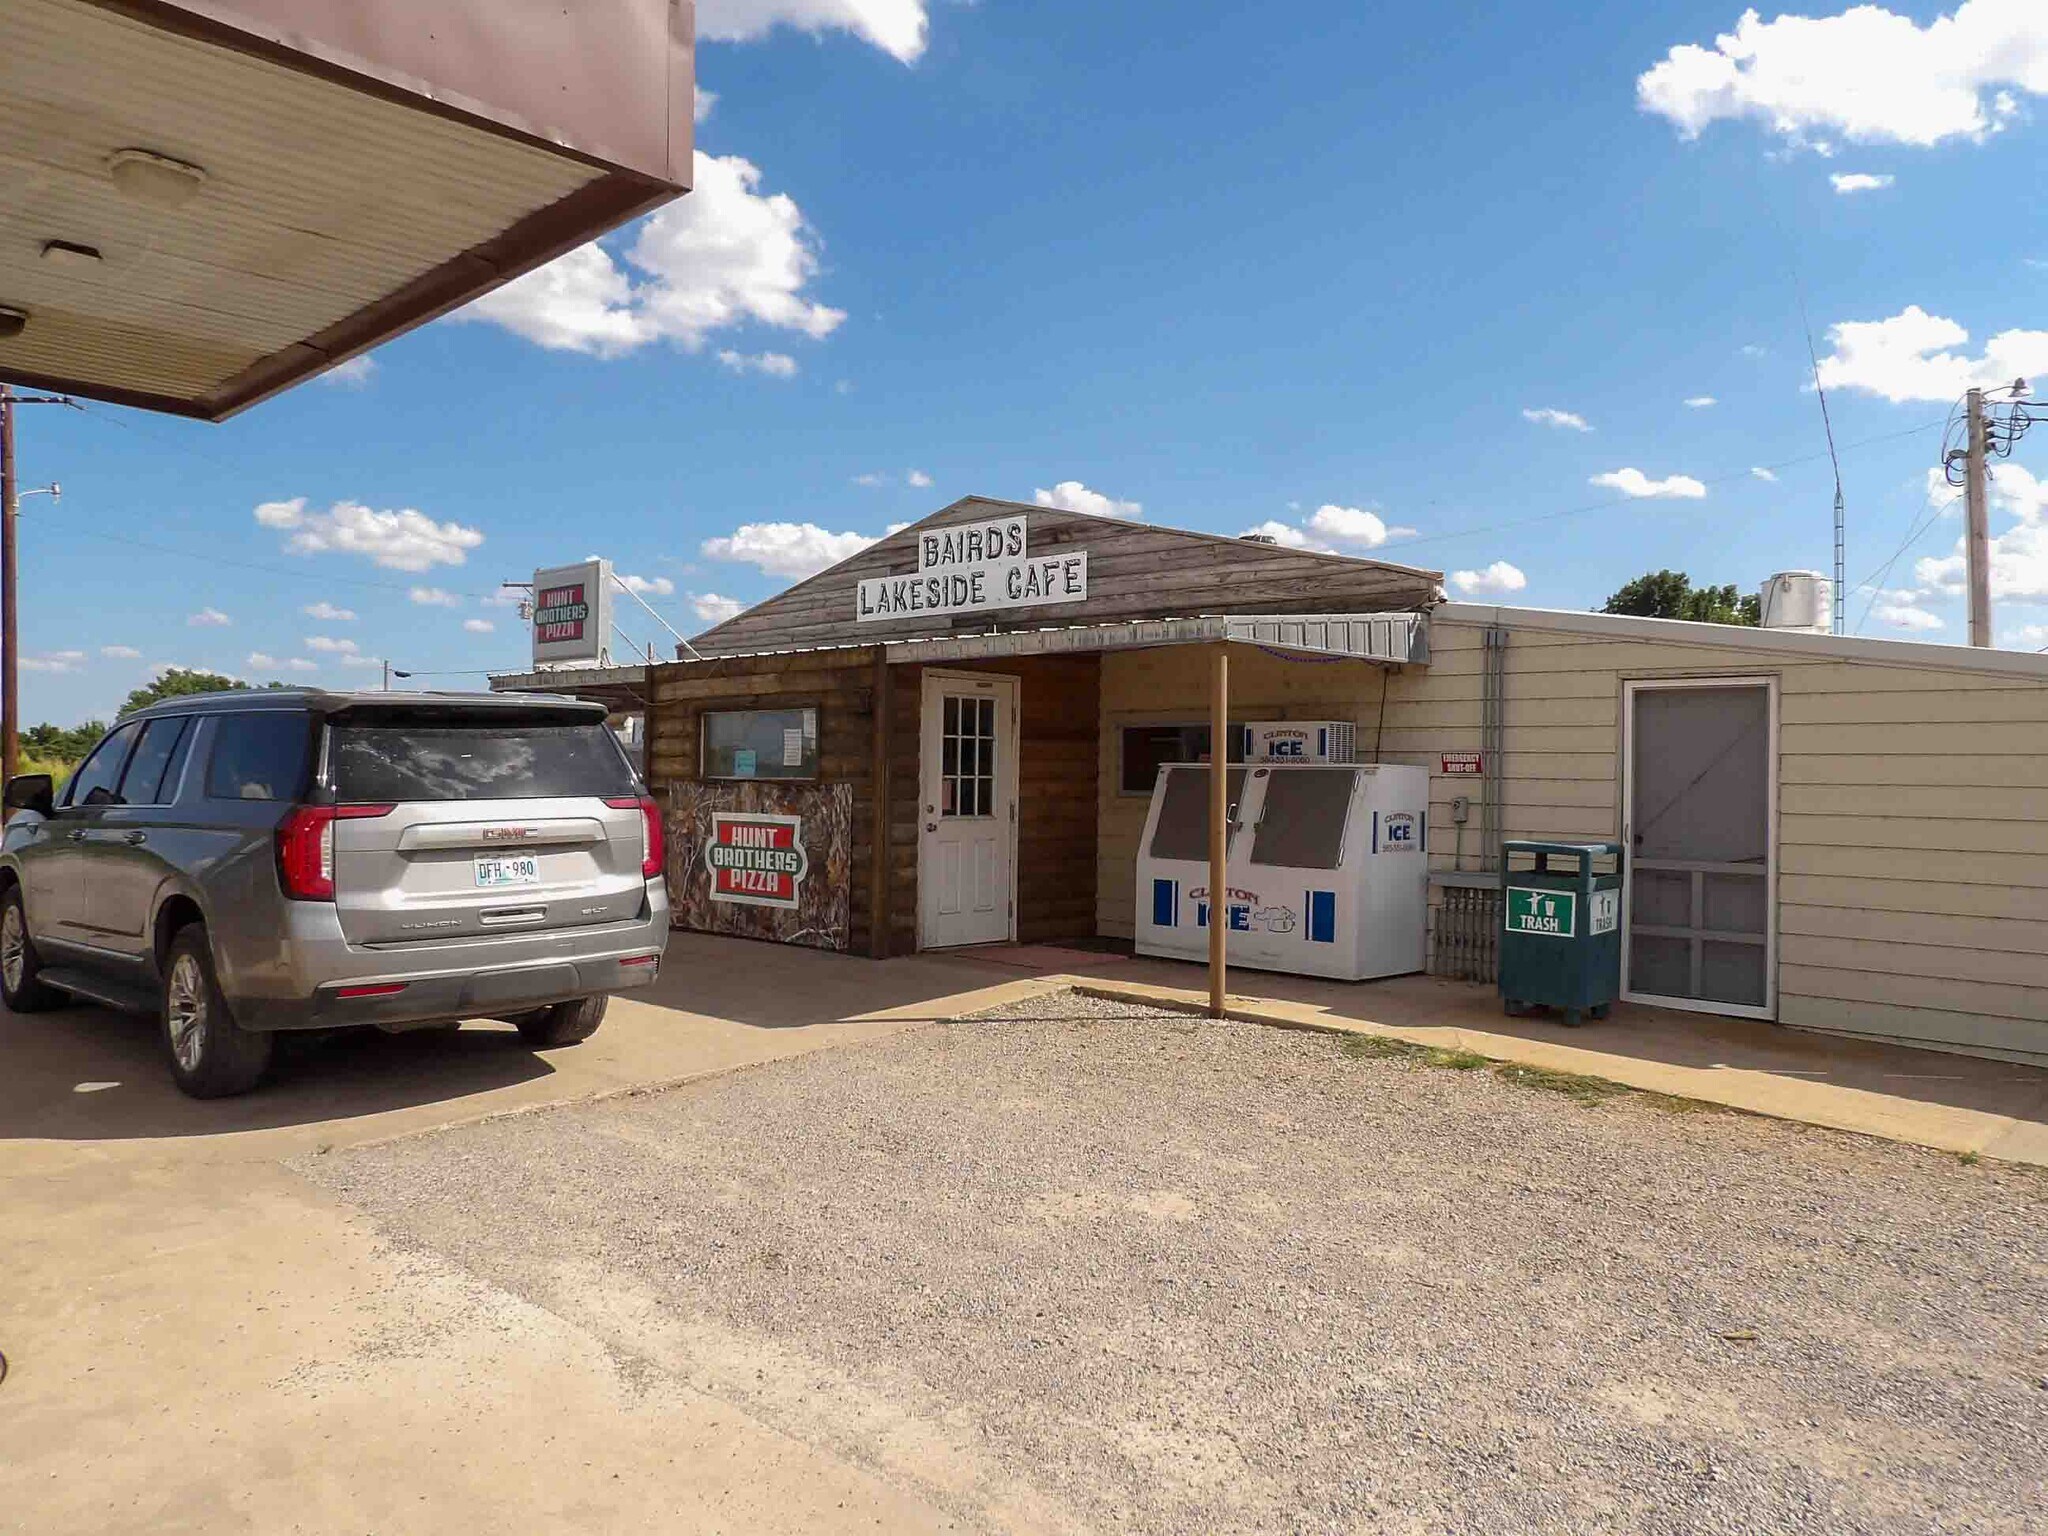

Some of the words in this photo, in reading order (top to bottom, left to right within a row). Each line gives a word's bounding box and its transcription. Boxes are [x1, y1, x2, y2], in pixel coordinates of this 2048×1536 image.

[922, 522, 1022, 568] BAIRDS
[860, 570, 986, 615] LAKESIDE
[1006, 558, 1083, 600] CAFE
[546, 589, 576, 608] HUNT
[545, 621, 575, 639] PIZZA
[1269, 740, 1303, 756] ICE
[482, 827, 538, 841] GMC
[731, 826, 778, 848] HUNT
[1388, 825, 1410, 841] ICE
[713, 847, 798, 872] BROTHERS
[730, 868, 778, 892] PIZZA
[1189, 887, 1259, 905] CLTON
[1520, 914, 1559, 932] TRASH
[1594, 916, 1613, 931] TRASH
